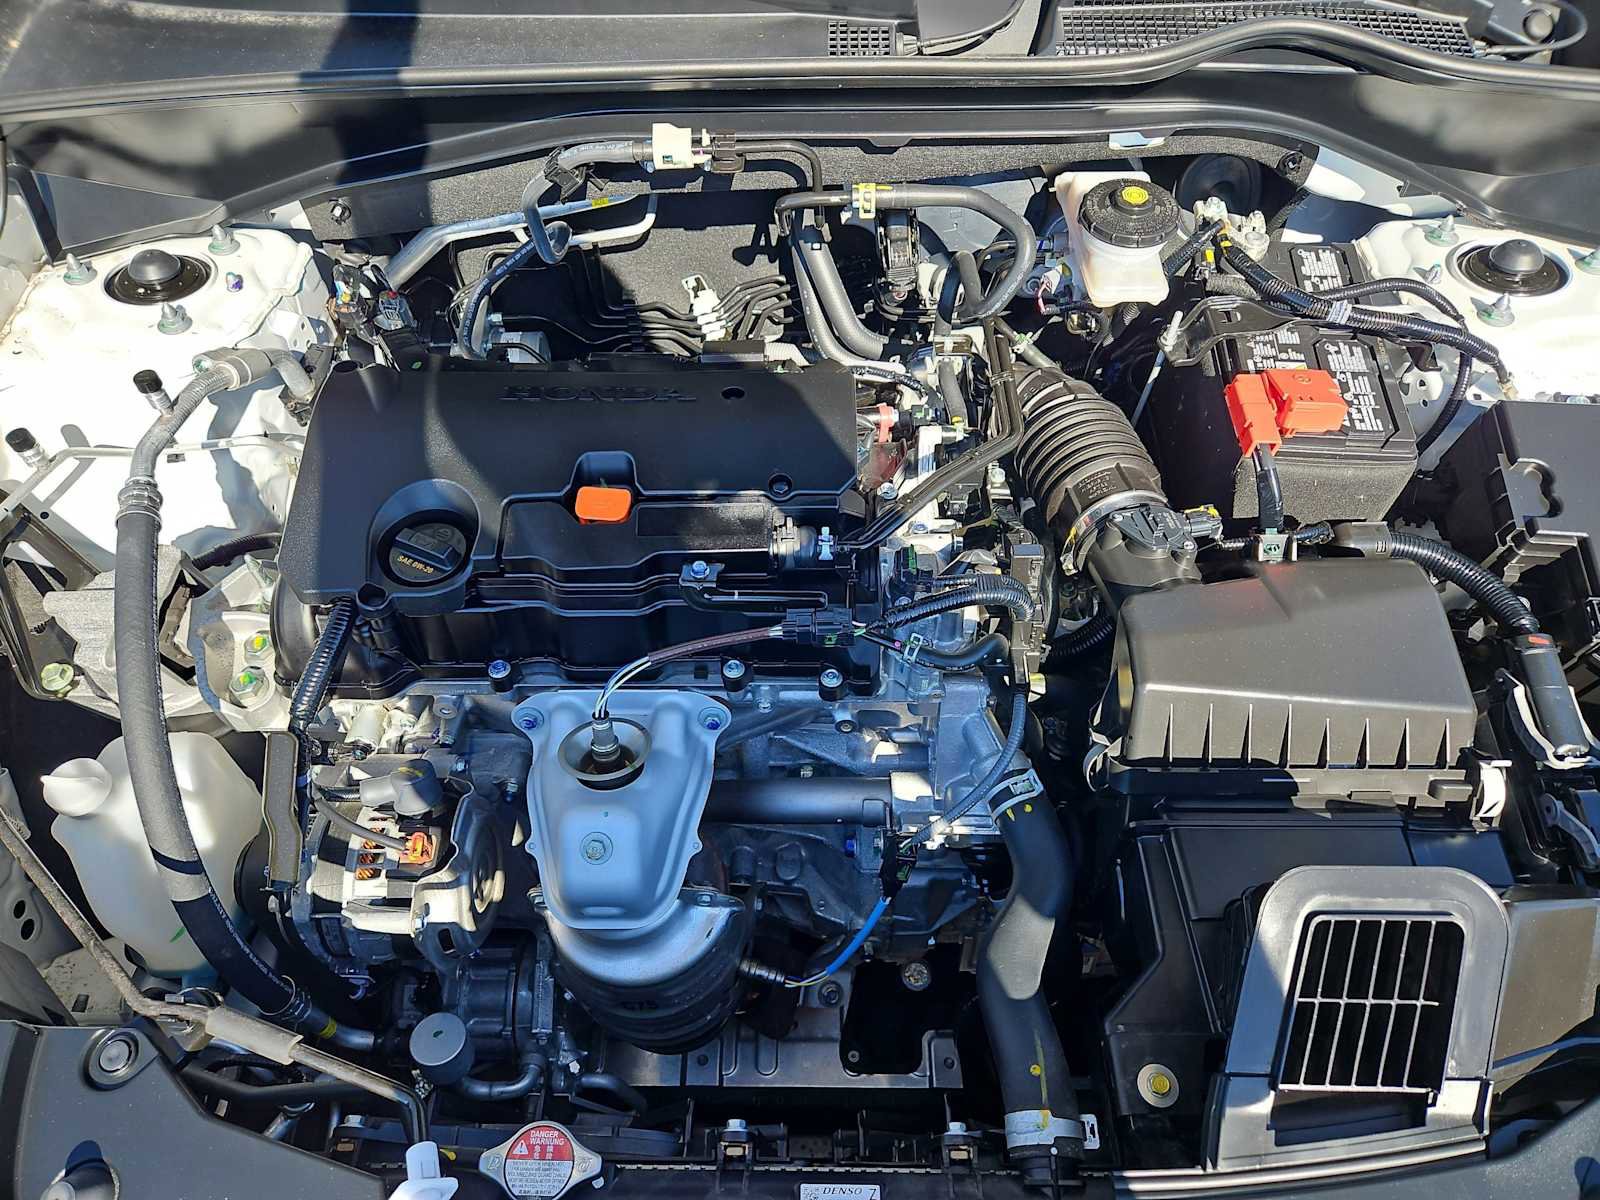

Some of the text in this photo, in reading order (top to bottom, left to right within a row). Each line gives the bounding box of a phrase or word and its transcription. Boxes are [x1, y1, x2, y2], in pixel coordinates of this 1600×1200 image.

[498, 385, 697, 402] HONDA
[397, 556, 413, 566] SAE
[530, 1130, 559, 1138] DANGER
[529, 1137, 565, 1145] WARNUNG
[823, 1187, 863, 1195] DENSO
